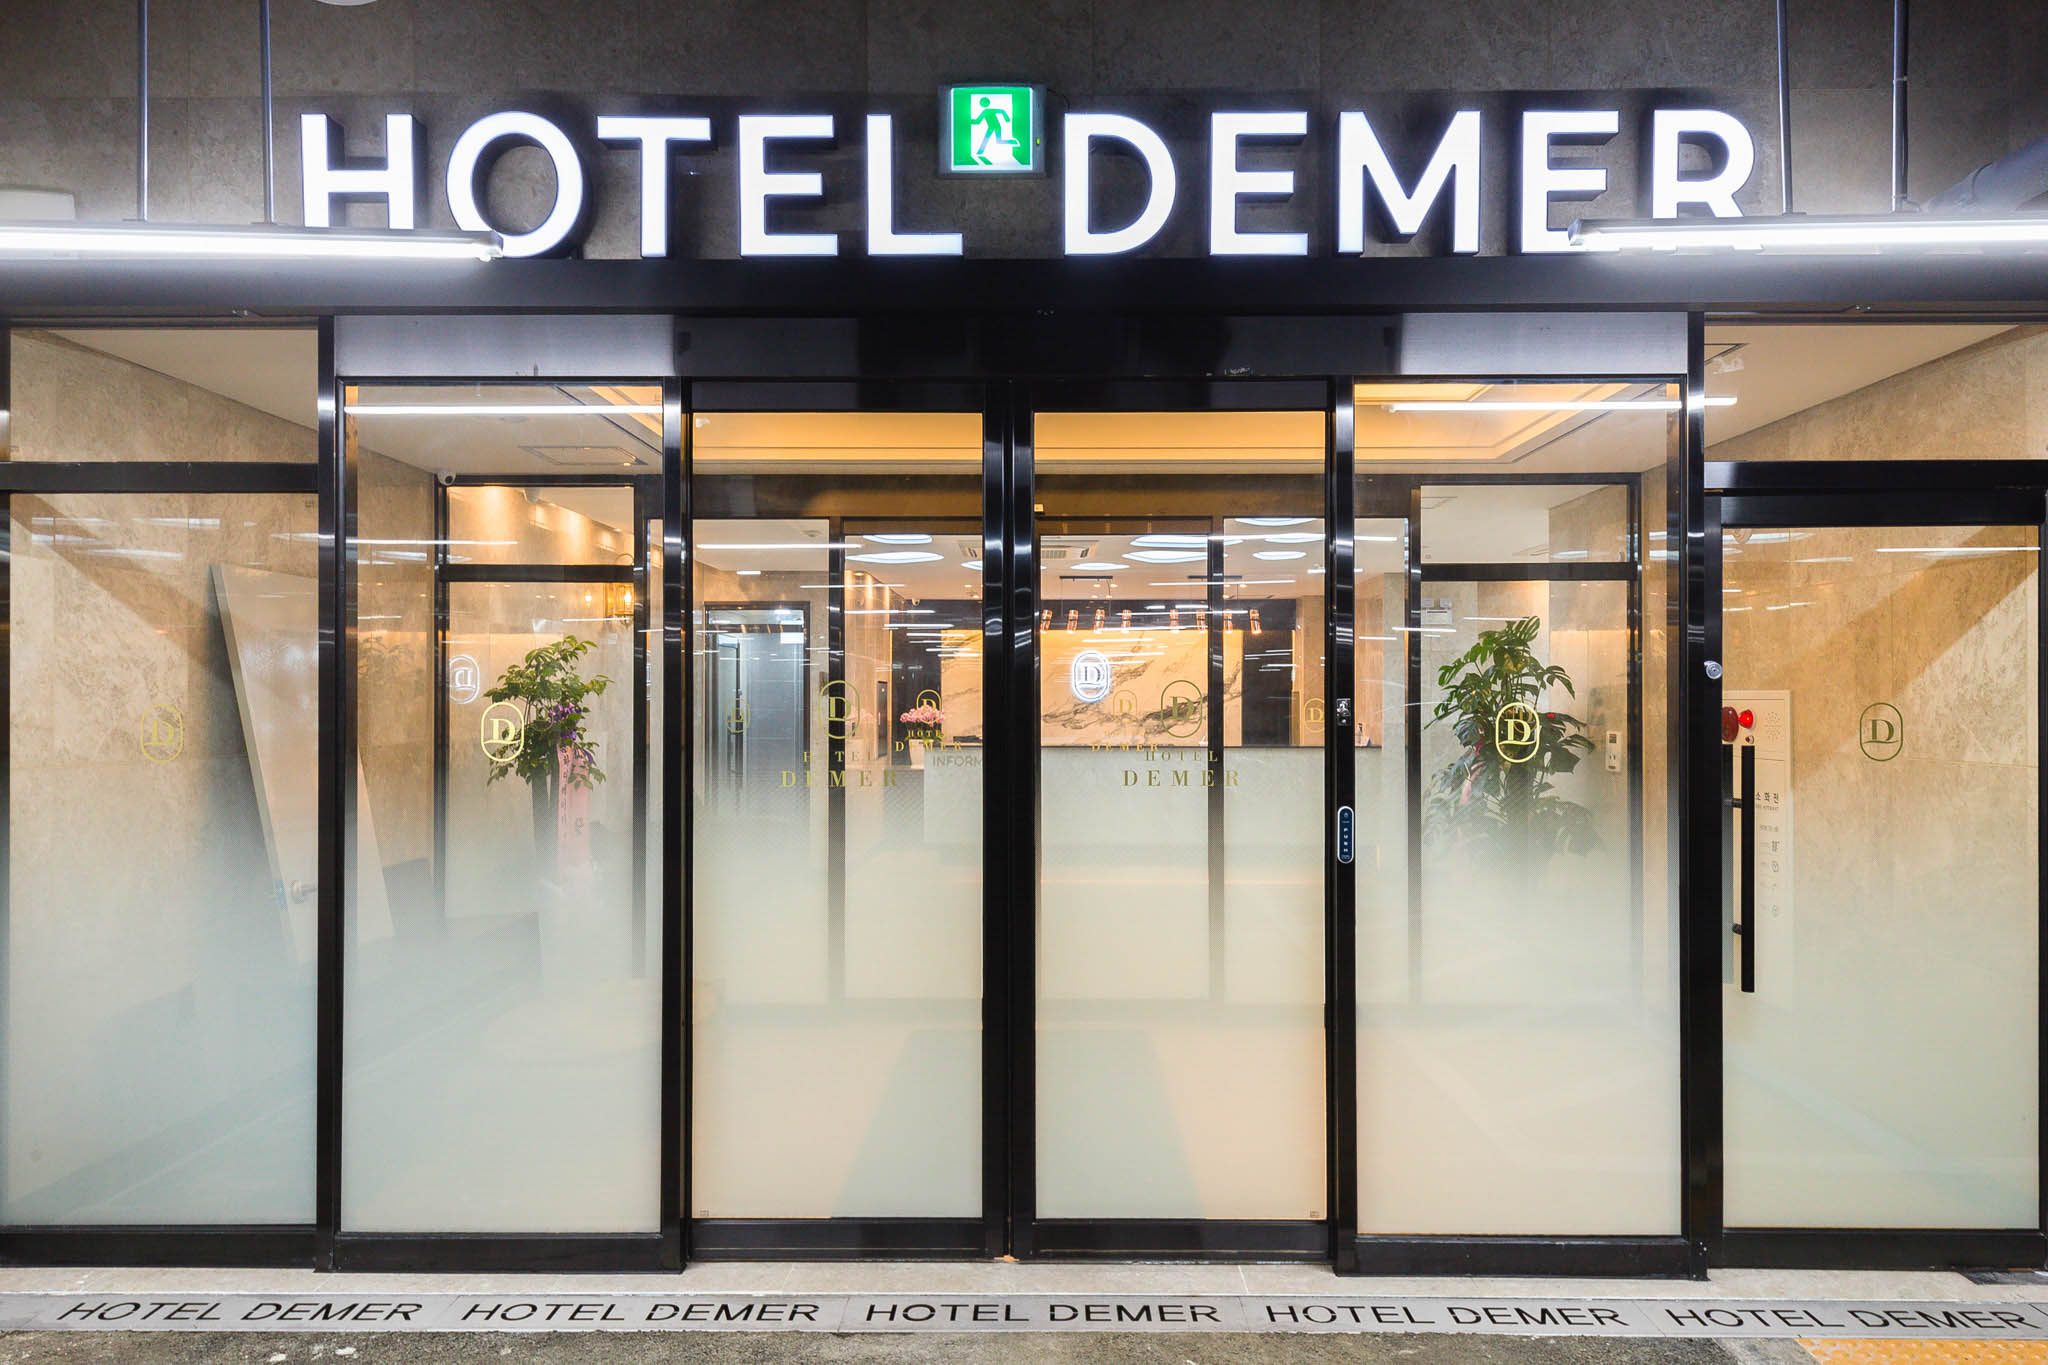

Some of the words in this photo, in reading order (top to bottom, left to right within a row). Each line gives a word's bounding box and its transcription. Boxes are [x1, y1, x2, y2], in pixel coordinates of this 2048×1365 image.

[300, 112, 964, 258] HOTEL
[1064, 109, 1760, 255] DEMER
[1144, 751, 1218, 762] HOTEL
[781, 770, 897, 788] DEMER
[1122, 769, 1240, 787] DEMER
[57, 1302, 223, 1321] HOTEL
[241, 1302, 424, 1321] DEMER
[461, 1303, 625, 1321] HOTEL
[645, 1303, 819, 1322] DEMER
[866, 1304, 1029, 1321] HOTEL
[1050, 1304, 1222, 1322] DEMER
[1266, 1305, 1434, 1324] HOTEL
[1447, 1306, 1629, 1326] DEMER
[1665, 1308, 1845, 1328] HOTEL
[1847, 1309, 2044, 1330] DEMER
